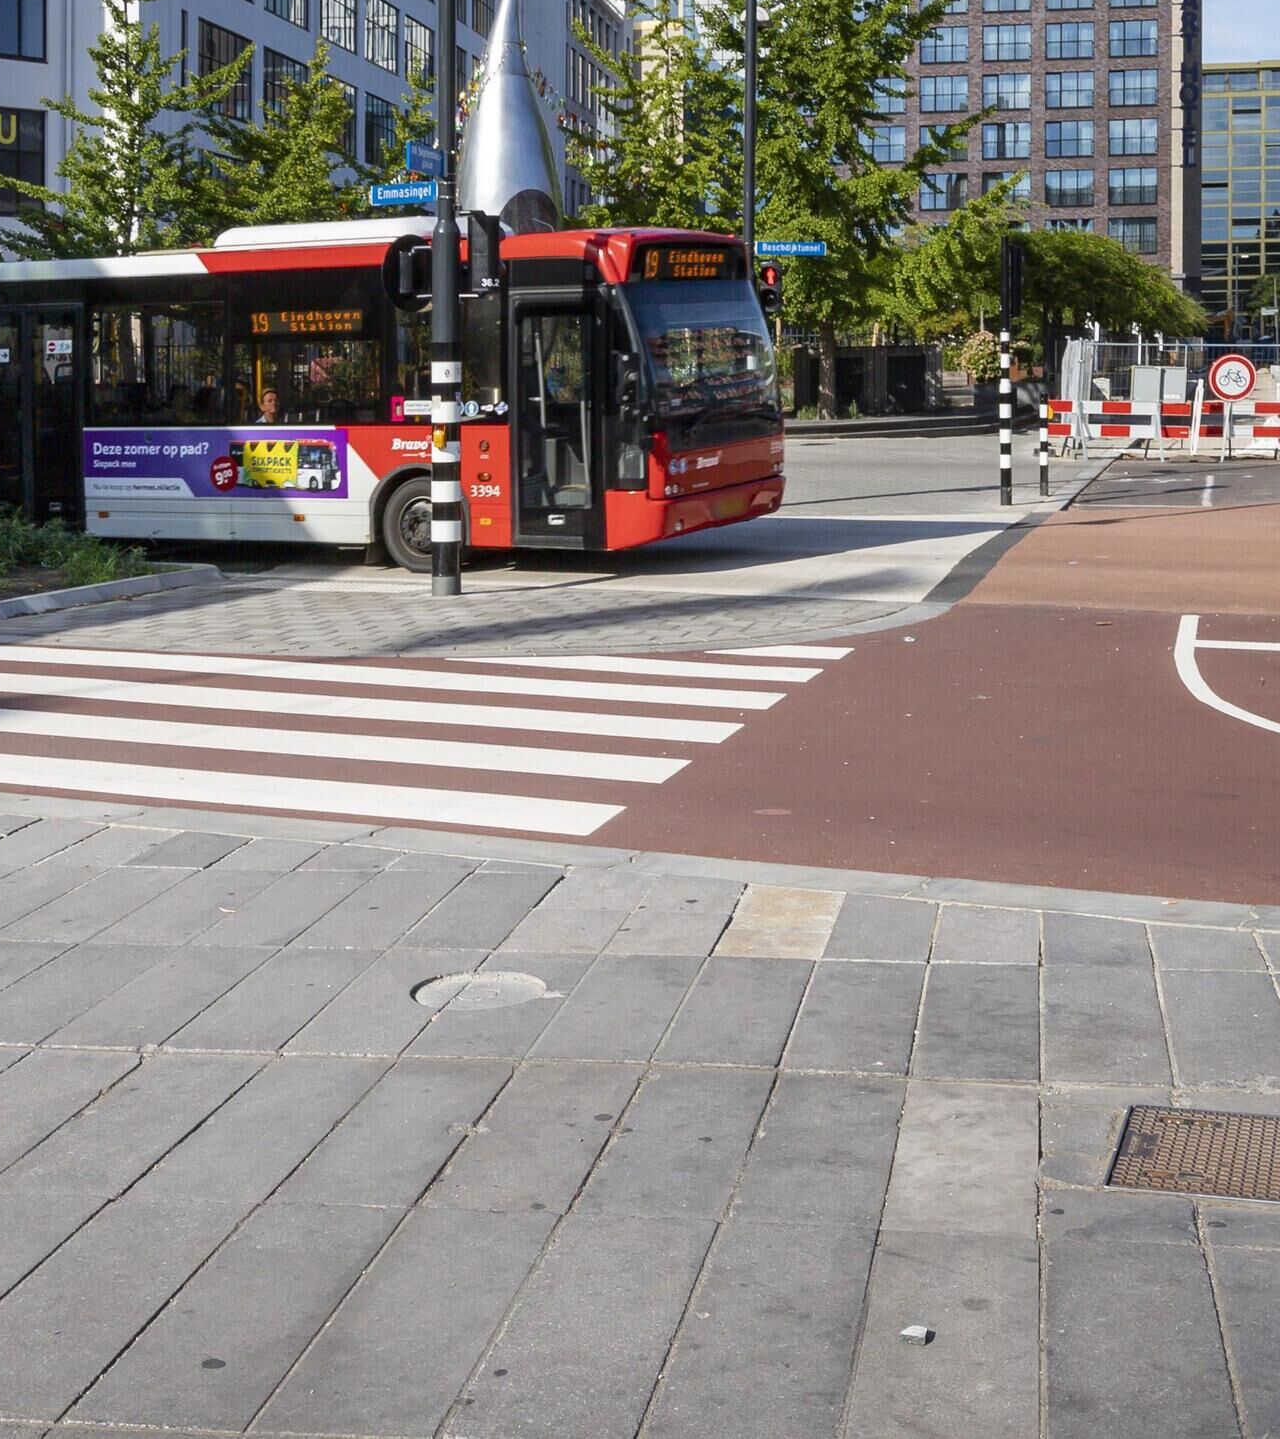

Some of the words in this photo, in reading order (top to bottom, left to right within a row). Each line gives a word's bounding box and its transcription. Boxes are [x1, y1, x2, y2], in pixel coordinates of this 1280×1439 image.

[1179, 62, 1199, 168] HOTEL
[377, 185, 432, 200] Emmasingel
[645, 249, 659, 279] 19
[669, 250, 724, 263] Eindhoven
[674, 264, 717, 278] Station
[481, 278, 500, 288] 36.2
[251, 313, 269, 333] 19
[280, 311, 361, 322] Eindhoven
[290, 321, 353, 332] Station
[93, 442, 122, 455] Deze
[124, 444, 160, 455] zomer
[162, 445, 177, 458] op
[179, 442, 209, 458] pad?
[391, 438, 429, 451] Bravo
[251, 456, 292, 466] SIXPACK
[470, 485, 501, 498] 3394
